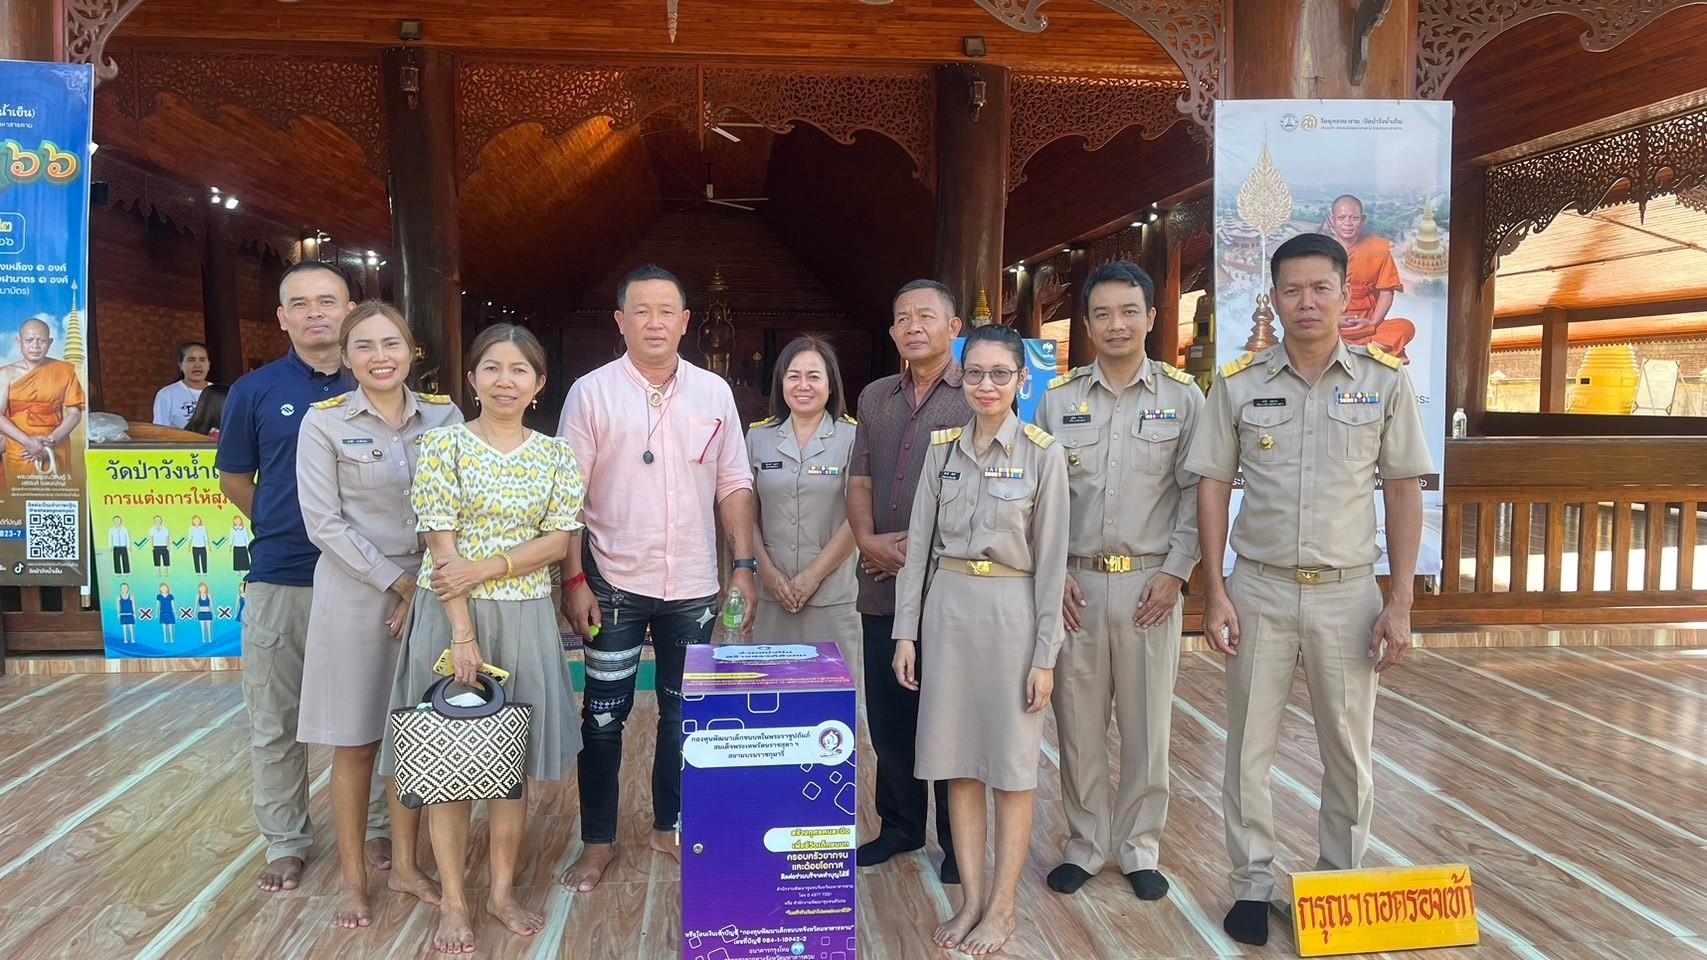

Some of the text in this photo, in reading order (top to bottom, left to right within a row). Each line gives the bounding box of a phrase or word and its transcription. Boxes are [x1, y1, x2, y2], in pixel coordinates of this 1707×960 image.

[0, 275, 35, 283] ฝาบาตร
[106, 453, 220, 480] วัดป่าวังน้ำเ
[103, 487, 233, 510] การแต่งการให้สุ
